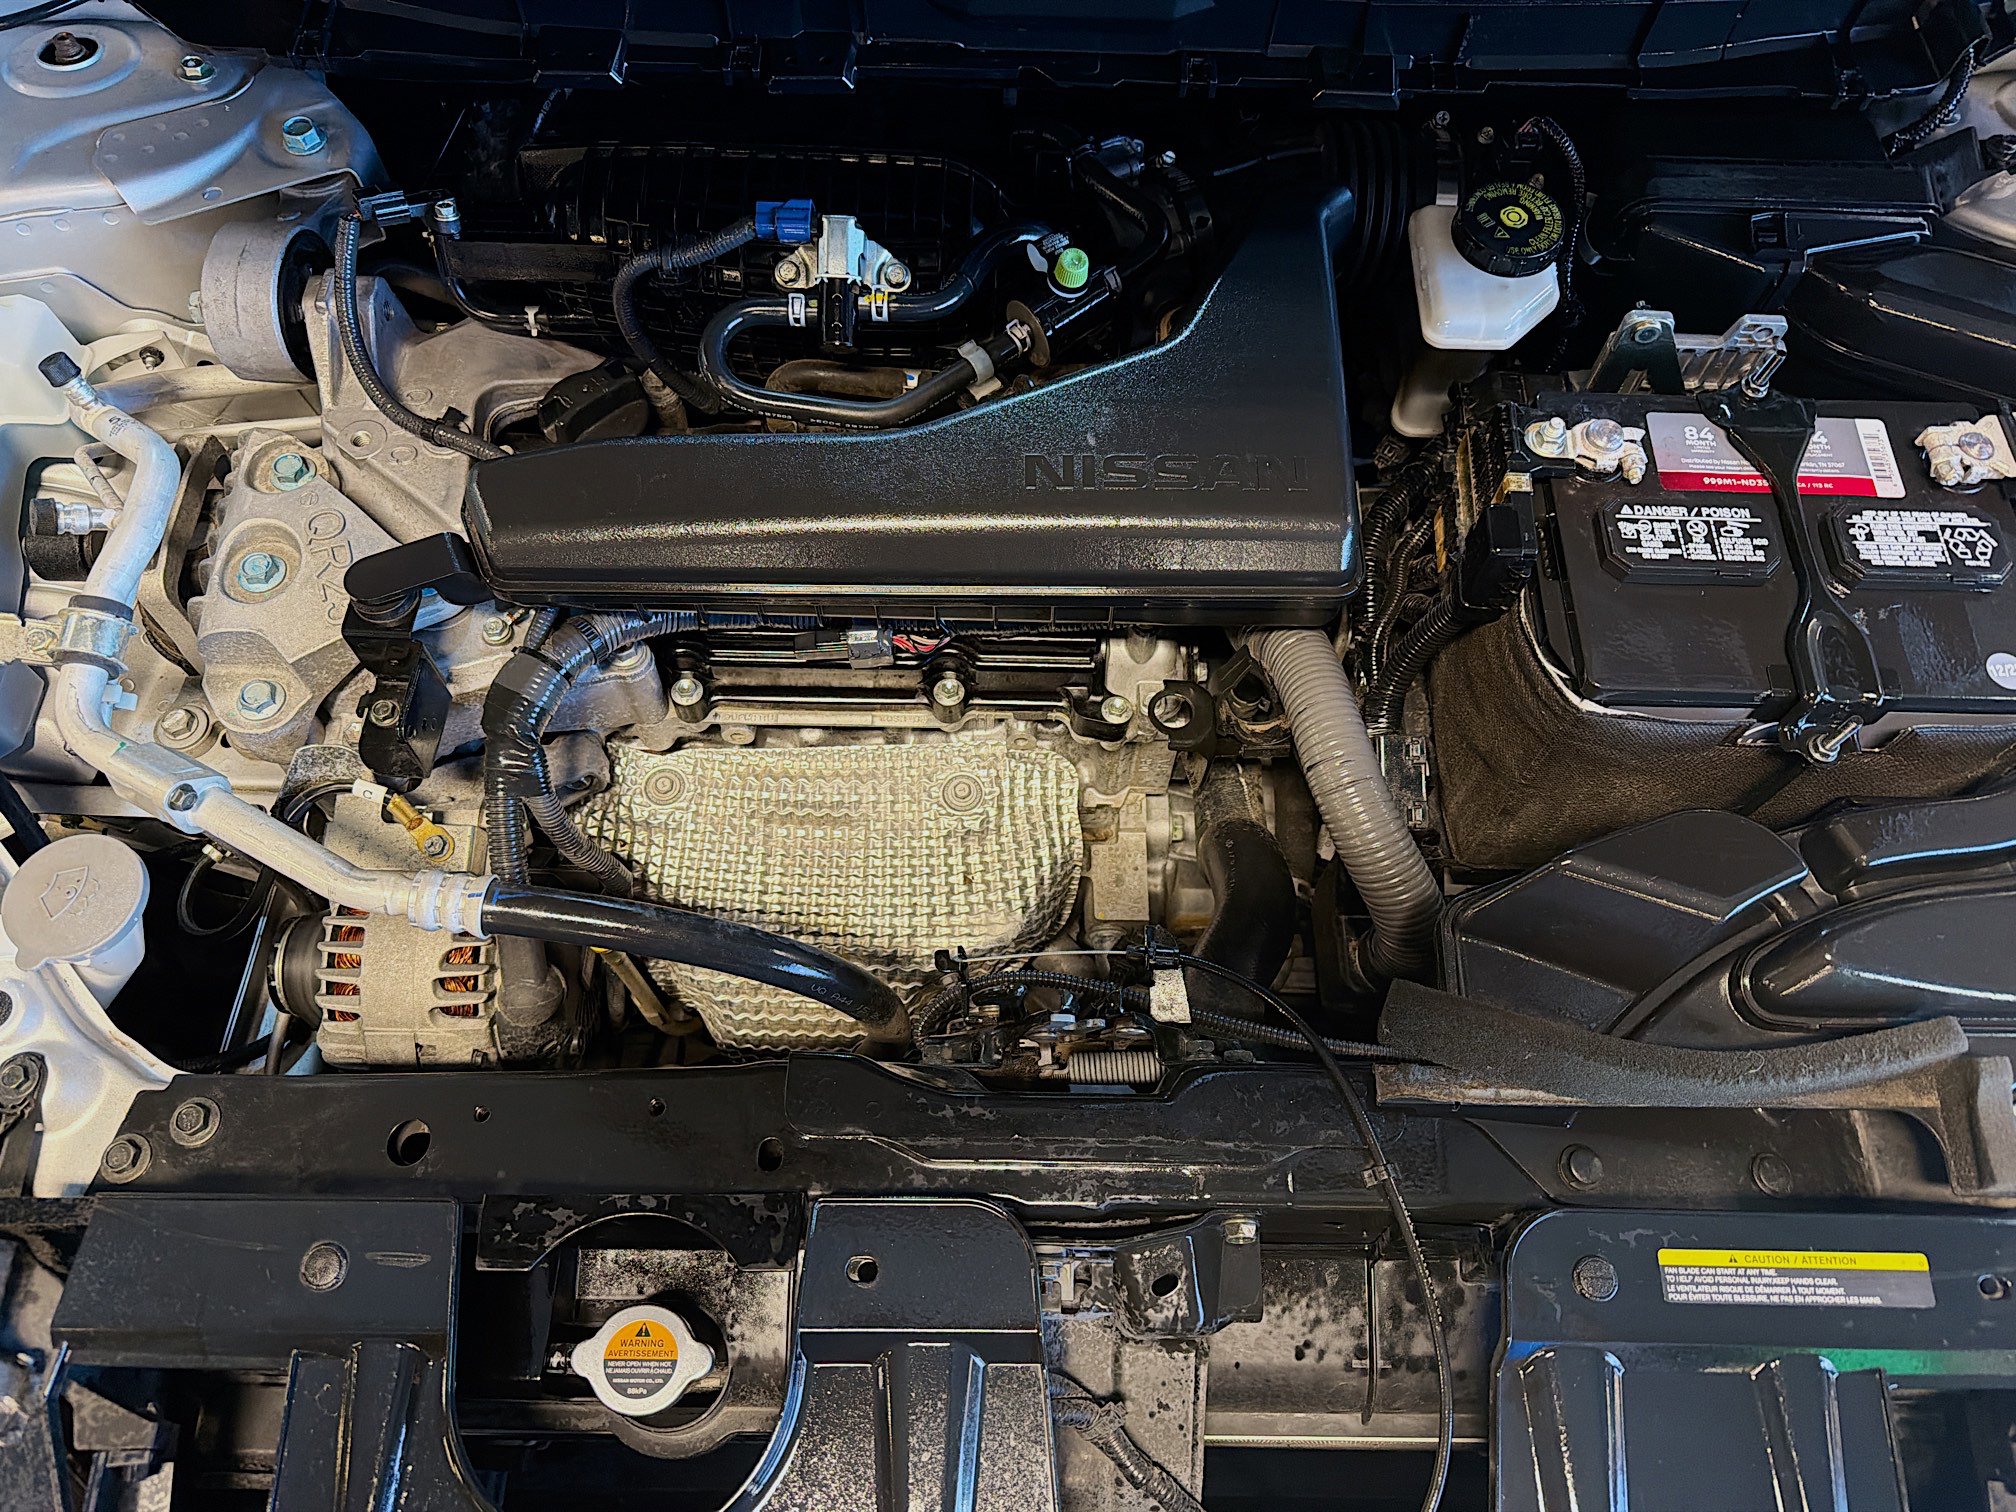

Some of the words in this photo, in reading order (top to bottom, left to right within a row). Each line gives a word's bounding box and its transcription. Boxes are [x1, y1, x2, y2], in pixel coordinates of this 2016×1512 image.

[1684, 426, 1715, 441] 84
[1810, 430, 1828, 444] 4
[1024, 454, 1308, 491] NISSAN
[1634, 505, 1688, 516] DANGER
[1690, 506, 1698, 516] /
[1701, 507, 1750, 518] POISON
[1990, 663, 2016, 678] 12/2
[1744, 1255, 1790, 1264] CAUTION
[1794, 1256, 1798, 1264] /
[1802, 1256, 1857, 1265] ATTENTION
[1666, 1275, 1676, 1283] TO
[1715, 1276, 1750, 1284] PERSONAL
[1719, 1286, 1743, 1294] RISQUE
[1712, 1294, 1732, 1302] TOUTE
[1846, 1296, 1859, 1304] LES
